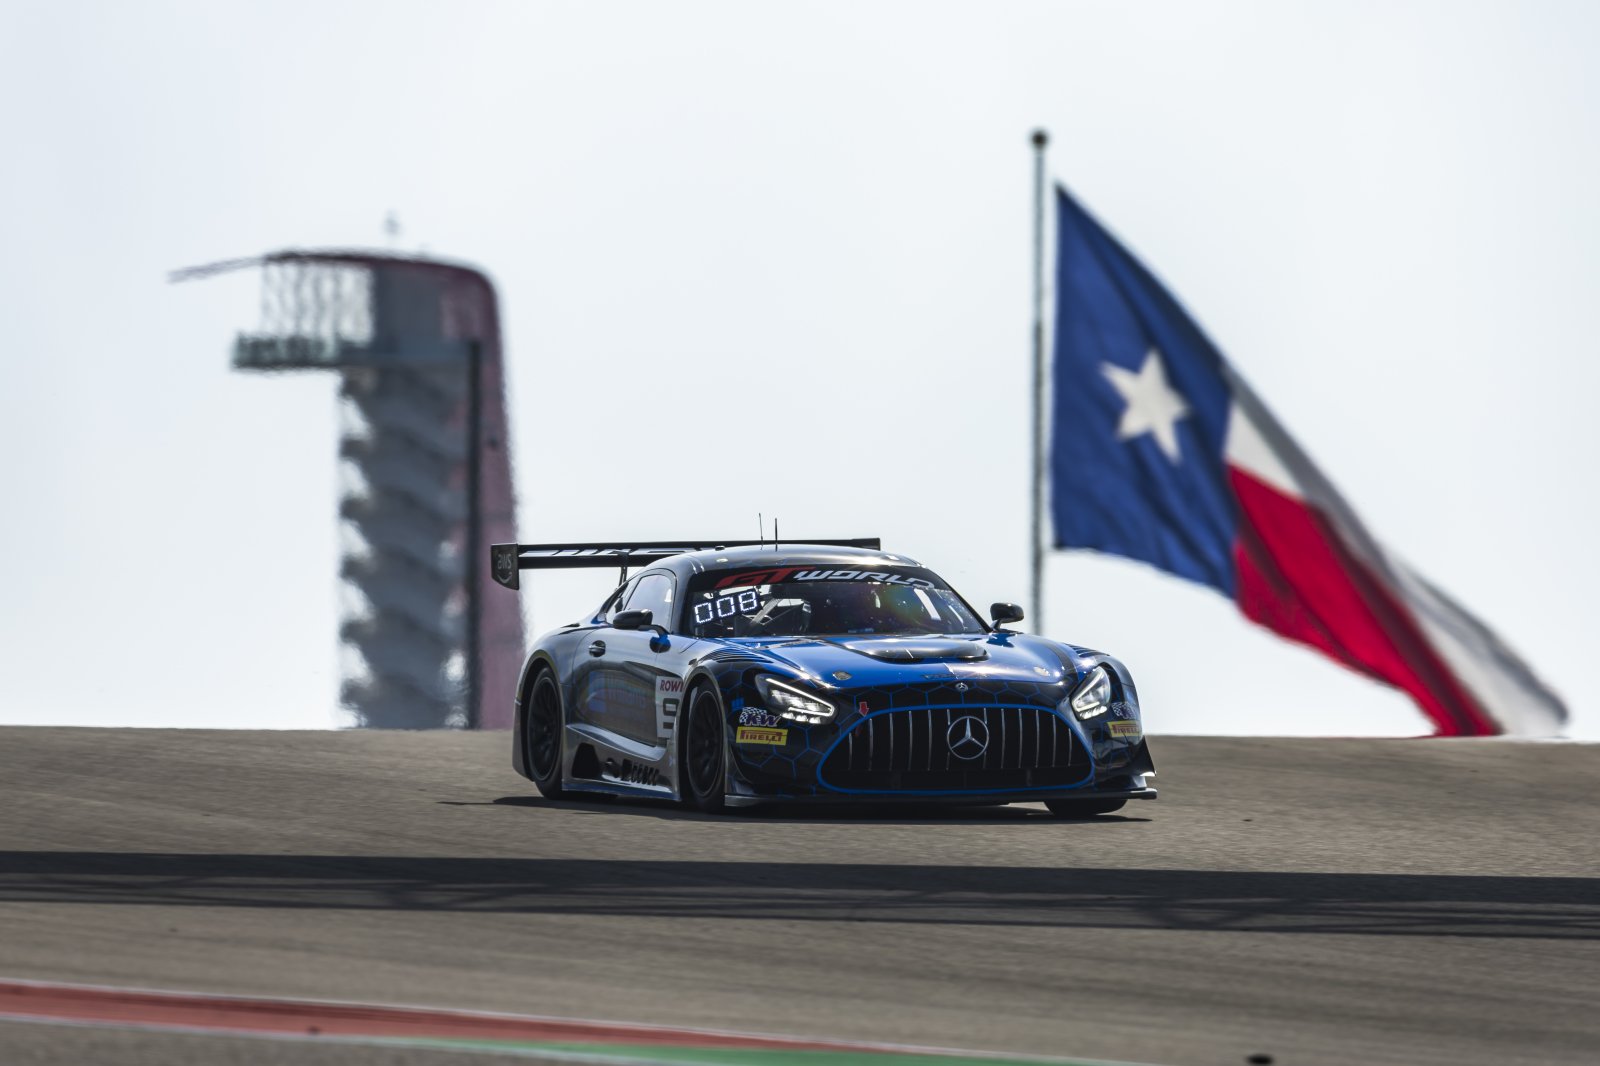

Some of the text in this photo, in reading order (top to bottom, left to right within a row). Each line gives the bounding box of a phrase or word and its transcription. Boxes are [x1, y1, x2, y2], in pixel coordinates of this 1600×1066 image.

[694, 591, 758, 624] 008
[744, 713, 781, 727] KW
[740, 730, 783, 741] PIRELLI
